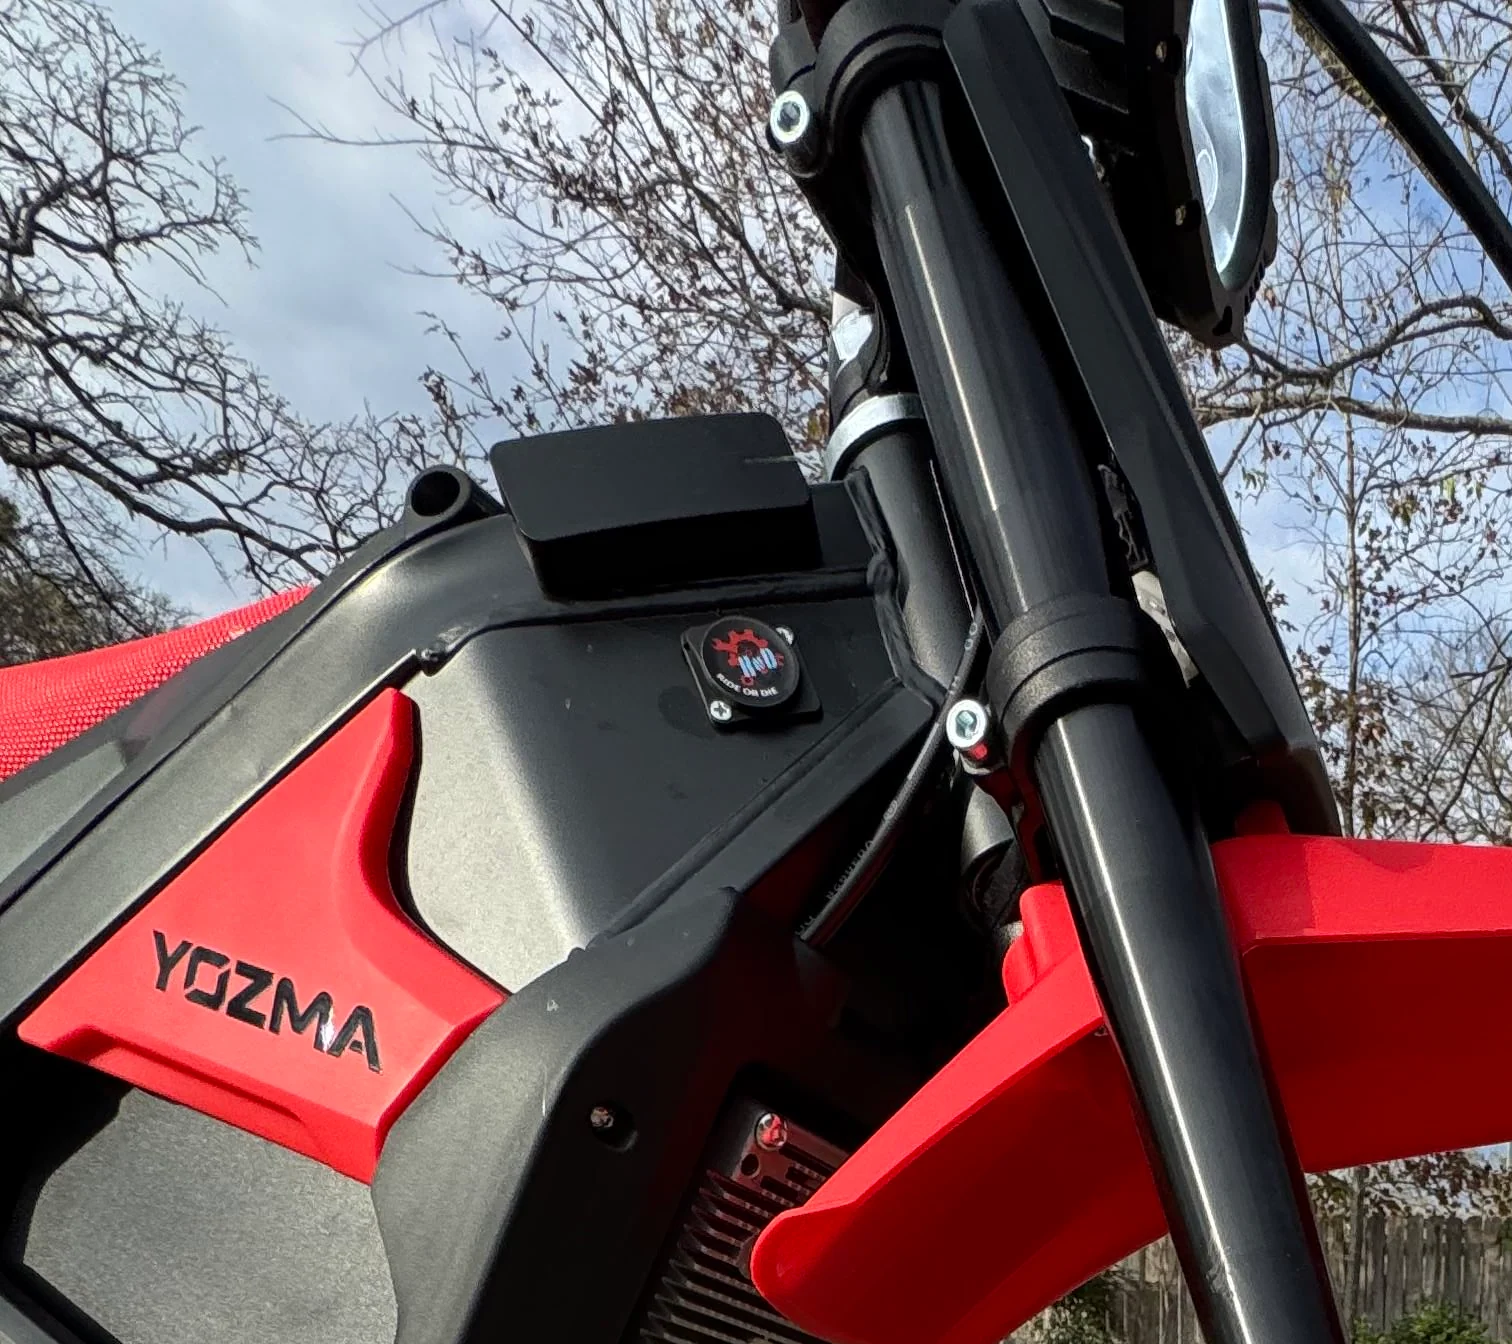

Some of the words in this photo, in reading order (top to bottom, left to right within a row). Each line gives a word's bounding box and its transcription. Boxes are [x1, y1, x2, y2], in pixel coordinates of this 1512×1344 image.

[716, 672, 741, 692] RIDE
[742, 687, 760, 697] OR
[760, 686, 779, 697] DIE
[152, 930, 382, 1073] YOZMA
